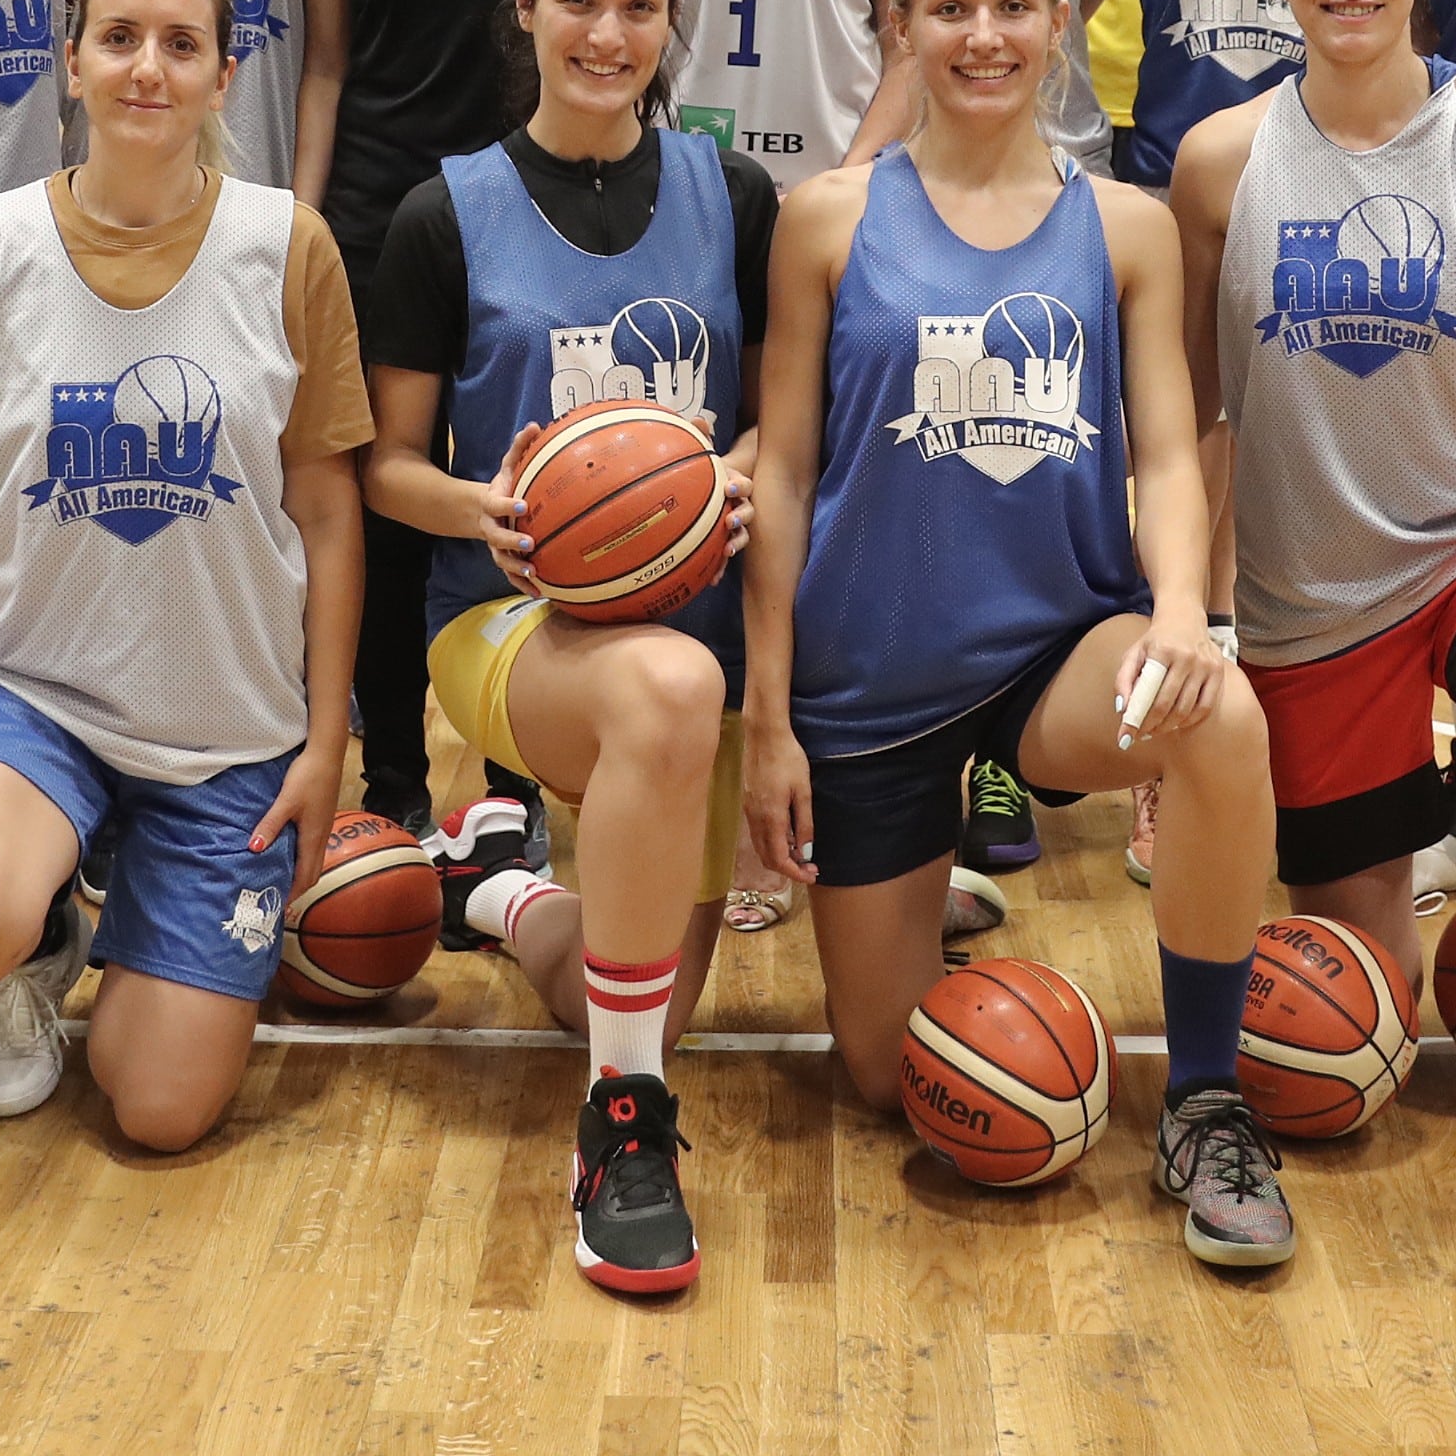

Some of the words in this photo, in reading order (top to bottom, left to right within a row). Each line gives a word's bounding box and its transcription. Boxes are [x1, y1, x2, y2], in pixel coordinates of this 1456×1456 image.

[1188, 31, 1211, 57] All
[1216, 28, 1306, 61] American
[741, 131, 804, 154] TEB
[1283, 323, 1314, 355] All
[1320, 318, 1434, 352] American
[924, 423, 958, 457] All
[964, 418, 1076, 458] American
[57, 490, 90, 522] All
[97, 484, 210, 518] American
[901, 1054, 993, 1135] molten
